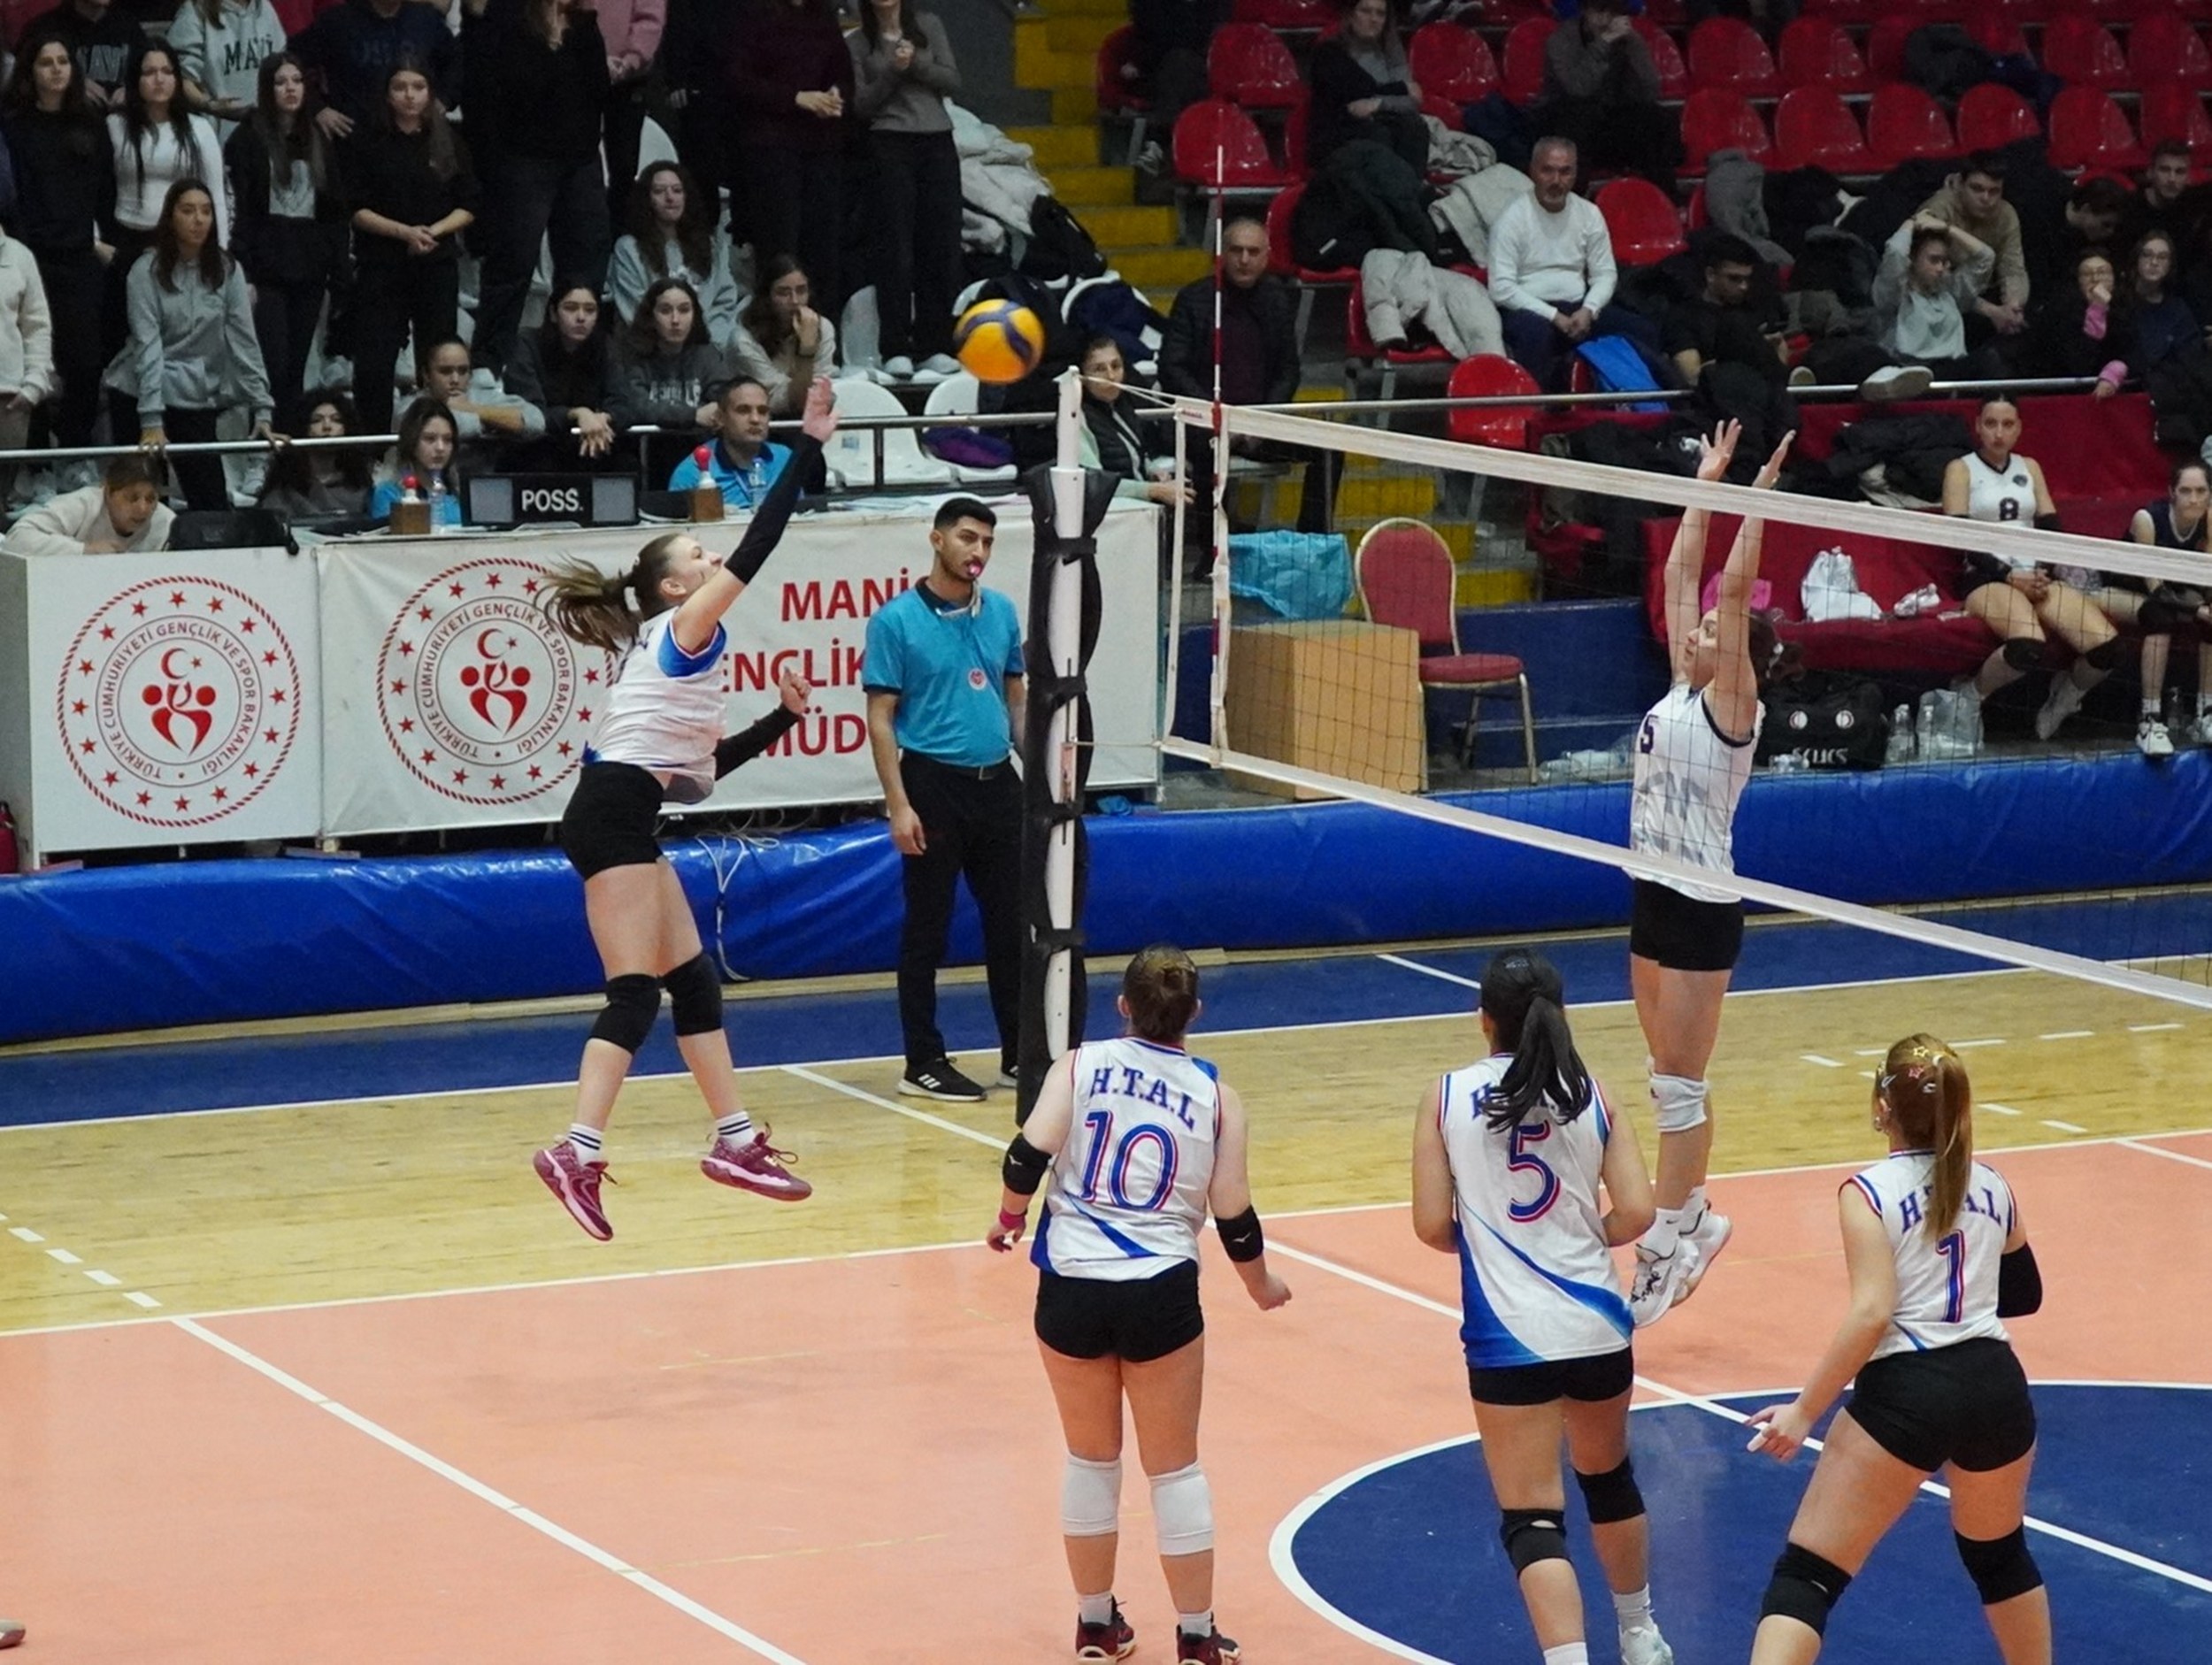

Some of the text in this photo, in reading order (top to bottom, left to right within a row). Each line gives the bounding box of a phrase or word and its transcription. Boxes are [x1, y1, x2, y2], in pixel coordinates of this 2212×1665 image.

[522, 487, 584, 511] POSS.
[1999, 497, 2019, 521] 8
[781, 567, 910, 621] MANİ
[103, 622, 257, 779] TÜRKİYE CUMHURİYETİ GENÇLİK VE SPOR BAKANLIĞI
[421, 603, 571, 758] TÜRKİYE CUMHURİYETİ GENÇLİK VE SPOR BAKANLIĞI
[1090, 1065, 1195, 1132] H.T.A.L
[1079, 1109, 1179, 1212] 10
[1507, 1119, 1561, 1223] 5
[1935, 1229, 1965, 1324] 1
